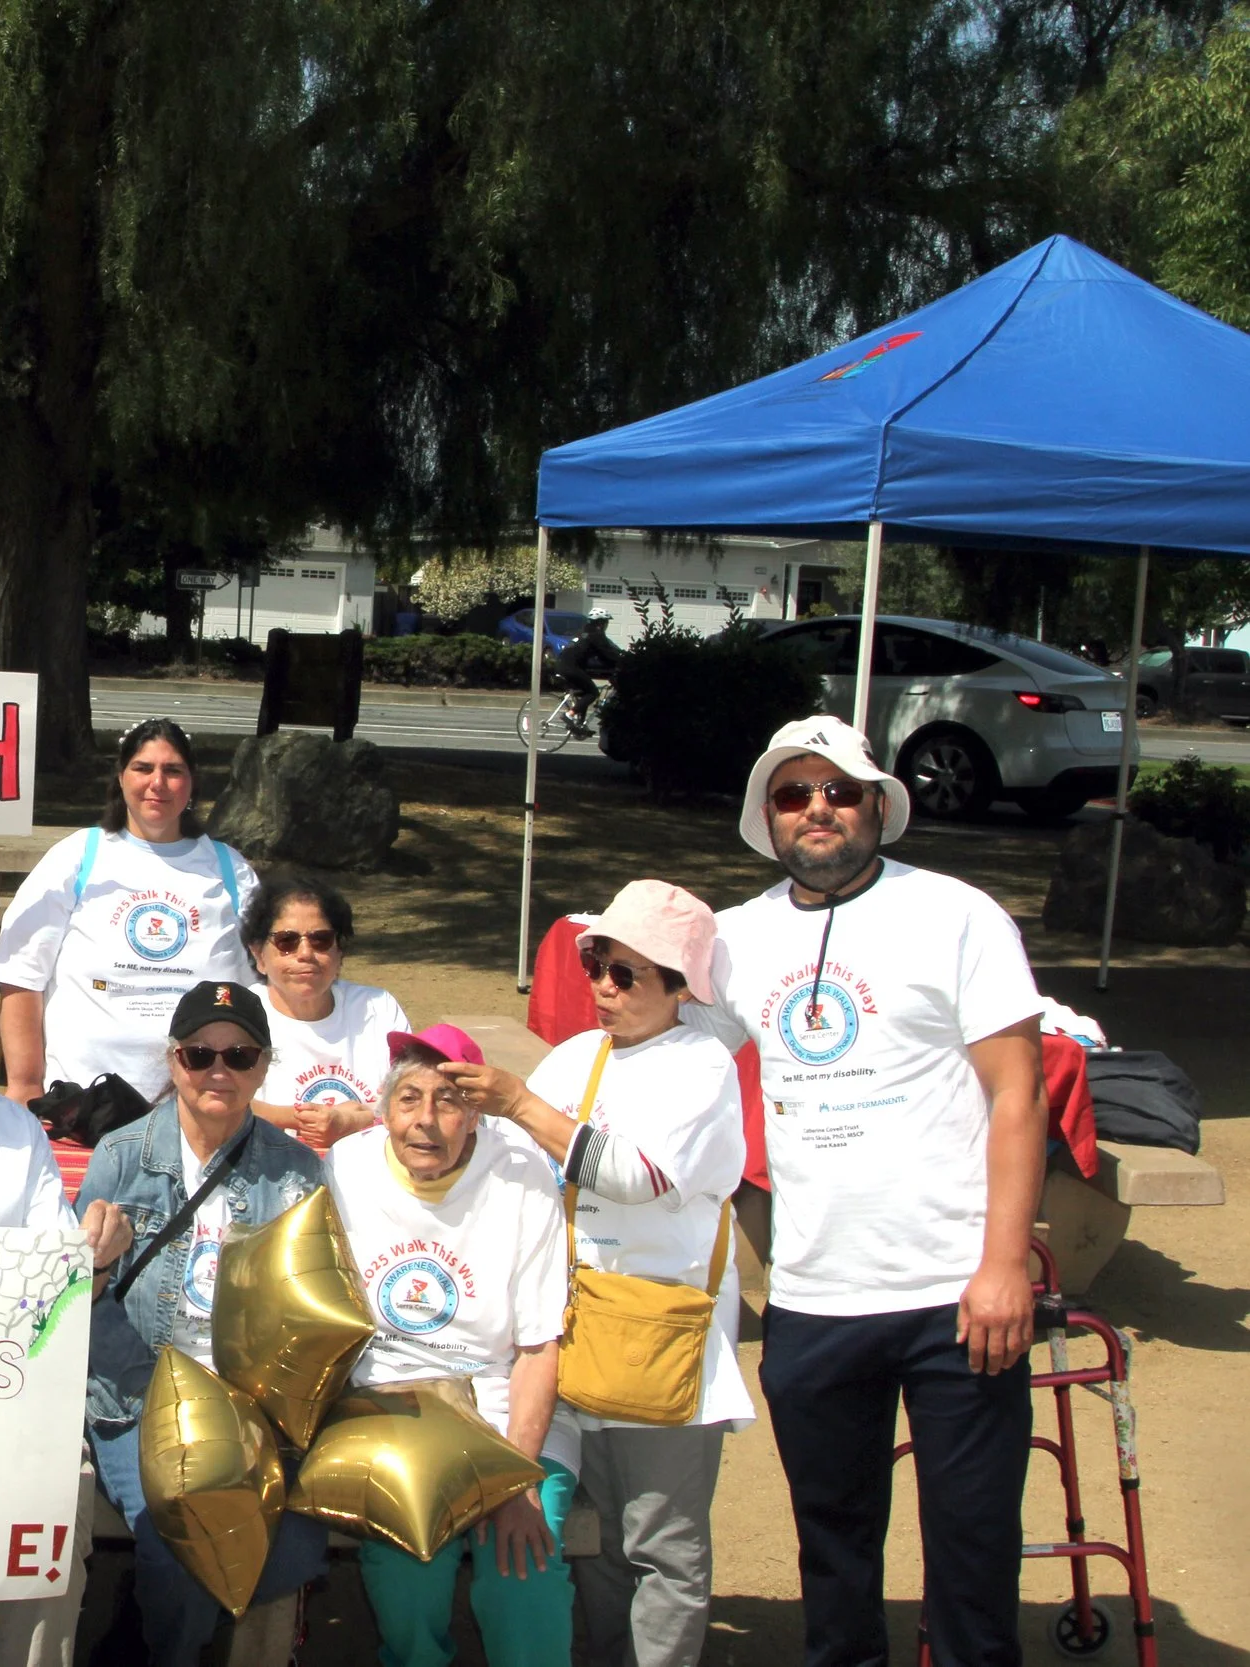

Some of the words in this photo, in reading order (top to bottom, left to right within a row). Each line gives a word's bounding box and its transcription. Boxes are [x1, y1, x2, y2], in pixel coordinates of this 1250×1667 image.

[182, 576, 198, 584] ONE
[201, 576, 215, 584] WAY
[110, 900, 130, 926] 2025
[129, 890, 158, 901] Walk
[165, 891, 186, 907] This
[189, 905, 200, 933] Way
[163, 966, 194, 975] disability.
[761, 990, 780, 1029] 2025
[780, 963, 819, 987] Walk
[825, 962, 854, 981] This
[854, 978, 878, 1015] Way
[832, 988, 852, 1014] WALK
[296, 1065, 326, 1085] Walk
[330, 1065, 354, 1081] This
[355, 1080, 376, 1103] Way
[782, 1075, 793, 1083] See
[833, 1067, 877, 1078] disability.
[832, 1101, 855, 1111] KAISER
[384, 1261, 437, 1289] AWARENESS
[436, 1271, 455, 1296] WALK
[390, 1239, 428, 1257] Walk
[431, 1241, 458, 1267] This
[458, 1263, 477, 1299] Way
[429, 1341, 470, 1351] disability.
